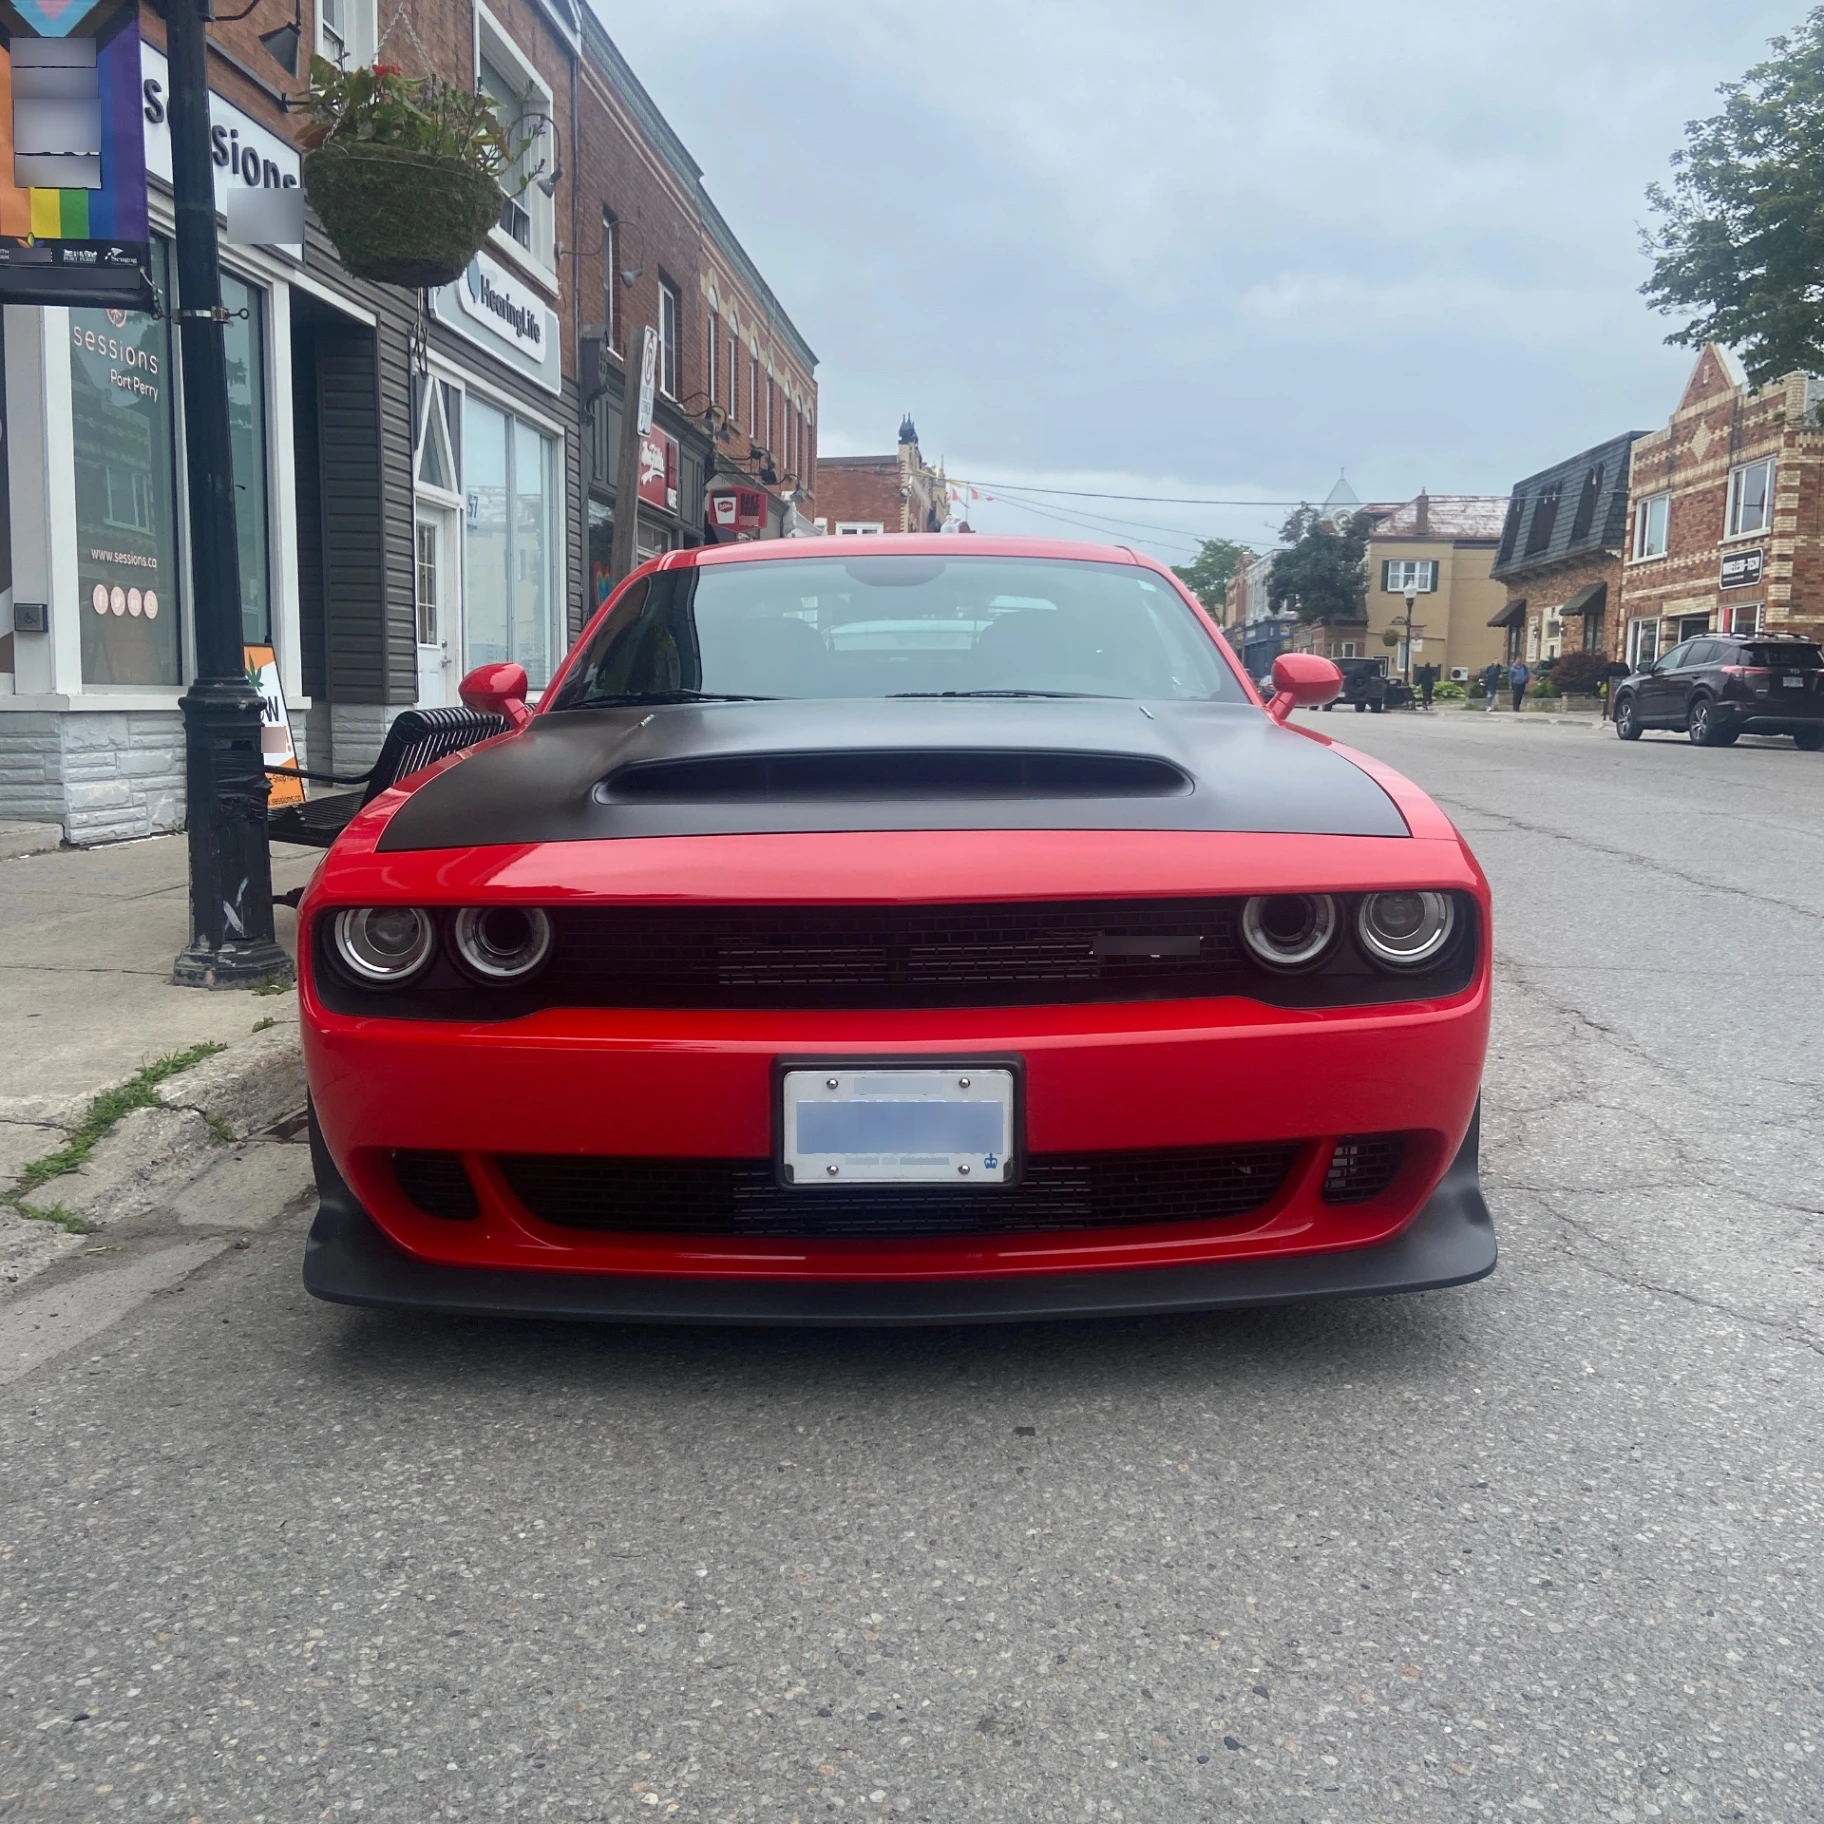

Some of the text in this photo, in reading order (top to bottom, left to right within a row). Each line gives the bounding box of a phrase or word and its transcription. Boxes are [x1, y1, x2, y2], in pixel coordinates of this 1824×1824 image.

[480, 274, 541, 344] HearingLife
[73, 326, 158, 374] sessions
[110, 368, 158, 404] Port Perry
